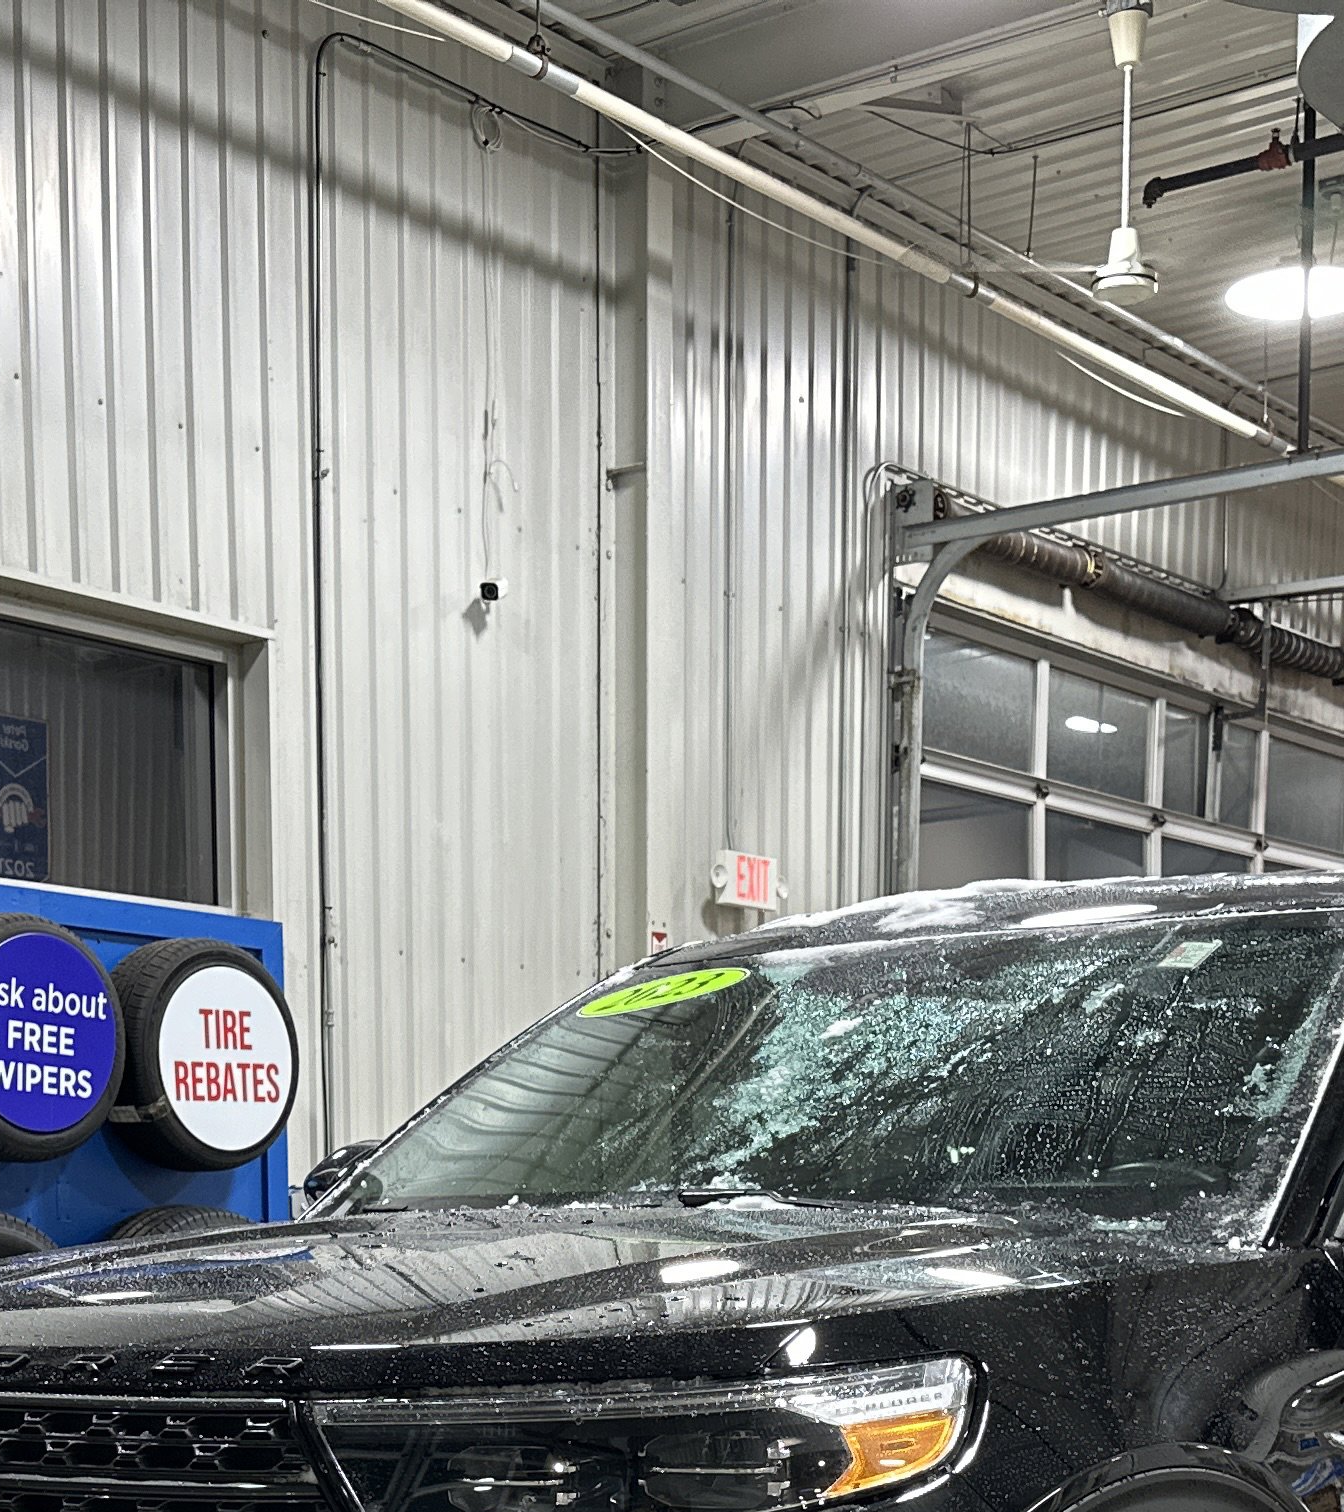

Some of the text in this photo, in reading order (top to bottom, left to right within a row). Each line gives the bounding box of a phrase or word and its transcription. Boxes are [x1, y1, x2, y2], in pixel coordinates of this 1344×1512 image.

[736, 855, 770, 903] EXIT
[31, 981, 108, 1022] about
[593, 972, 725, 1013] 2023
[6, 1019, 76, 1058] FREE
[198, 1008, 253, 1052] TIRE
[174, 1060, 280, 1104] REBATES
